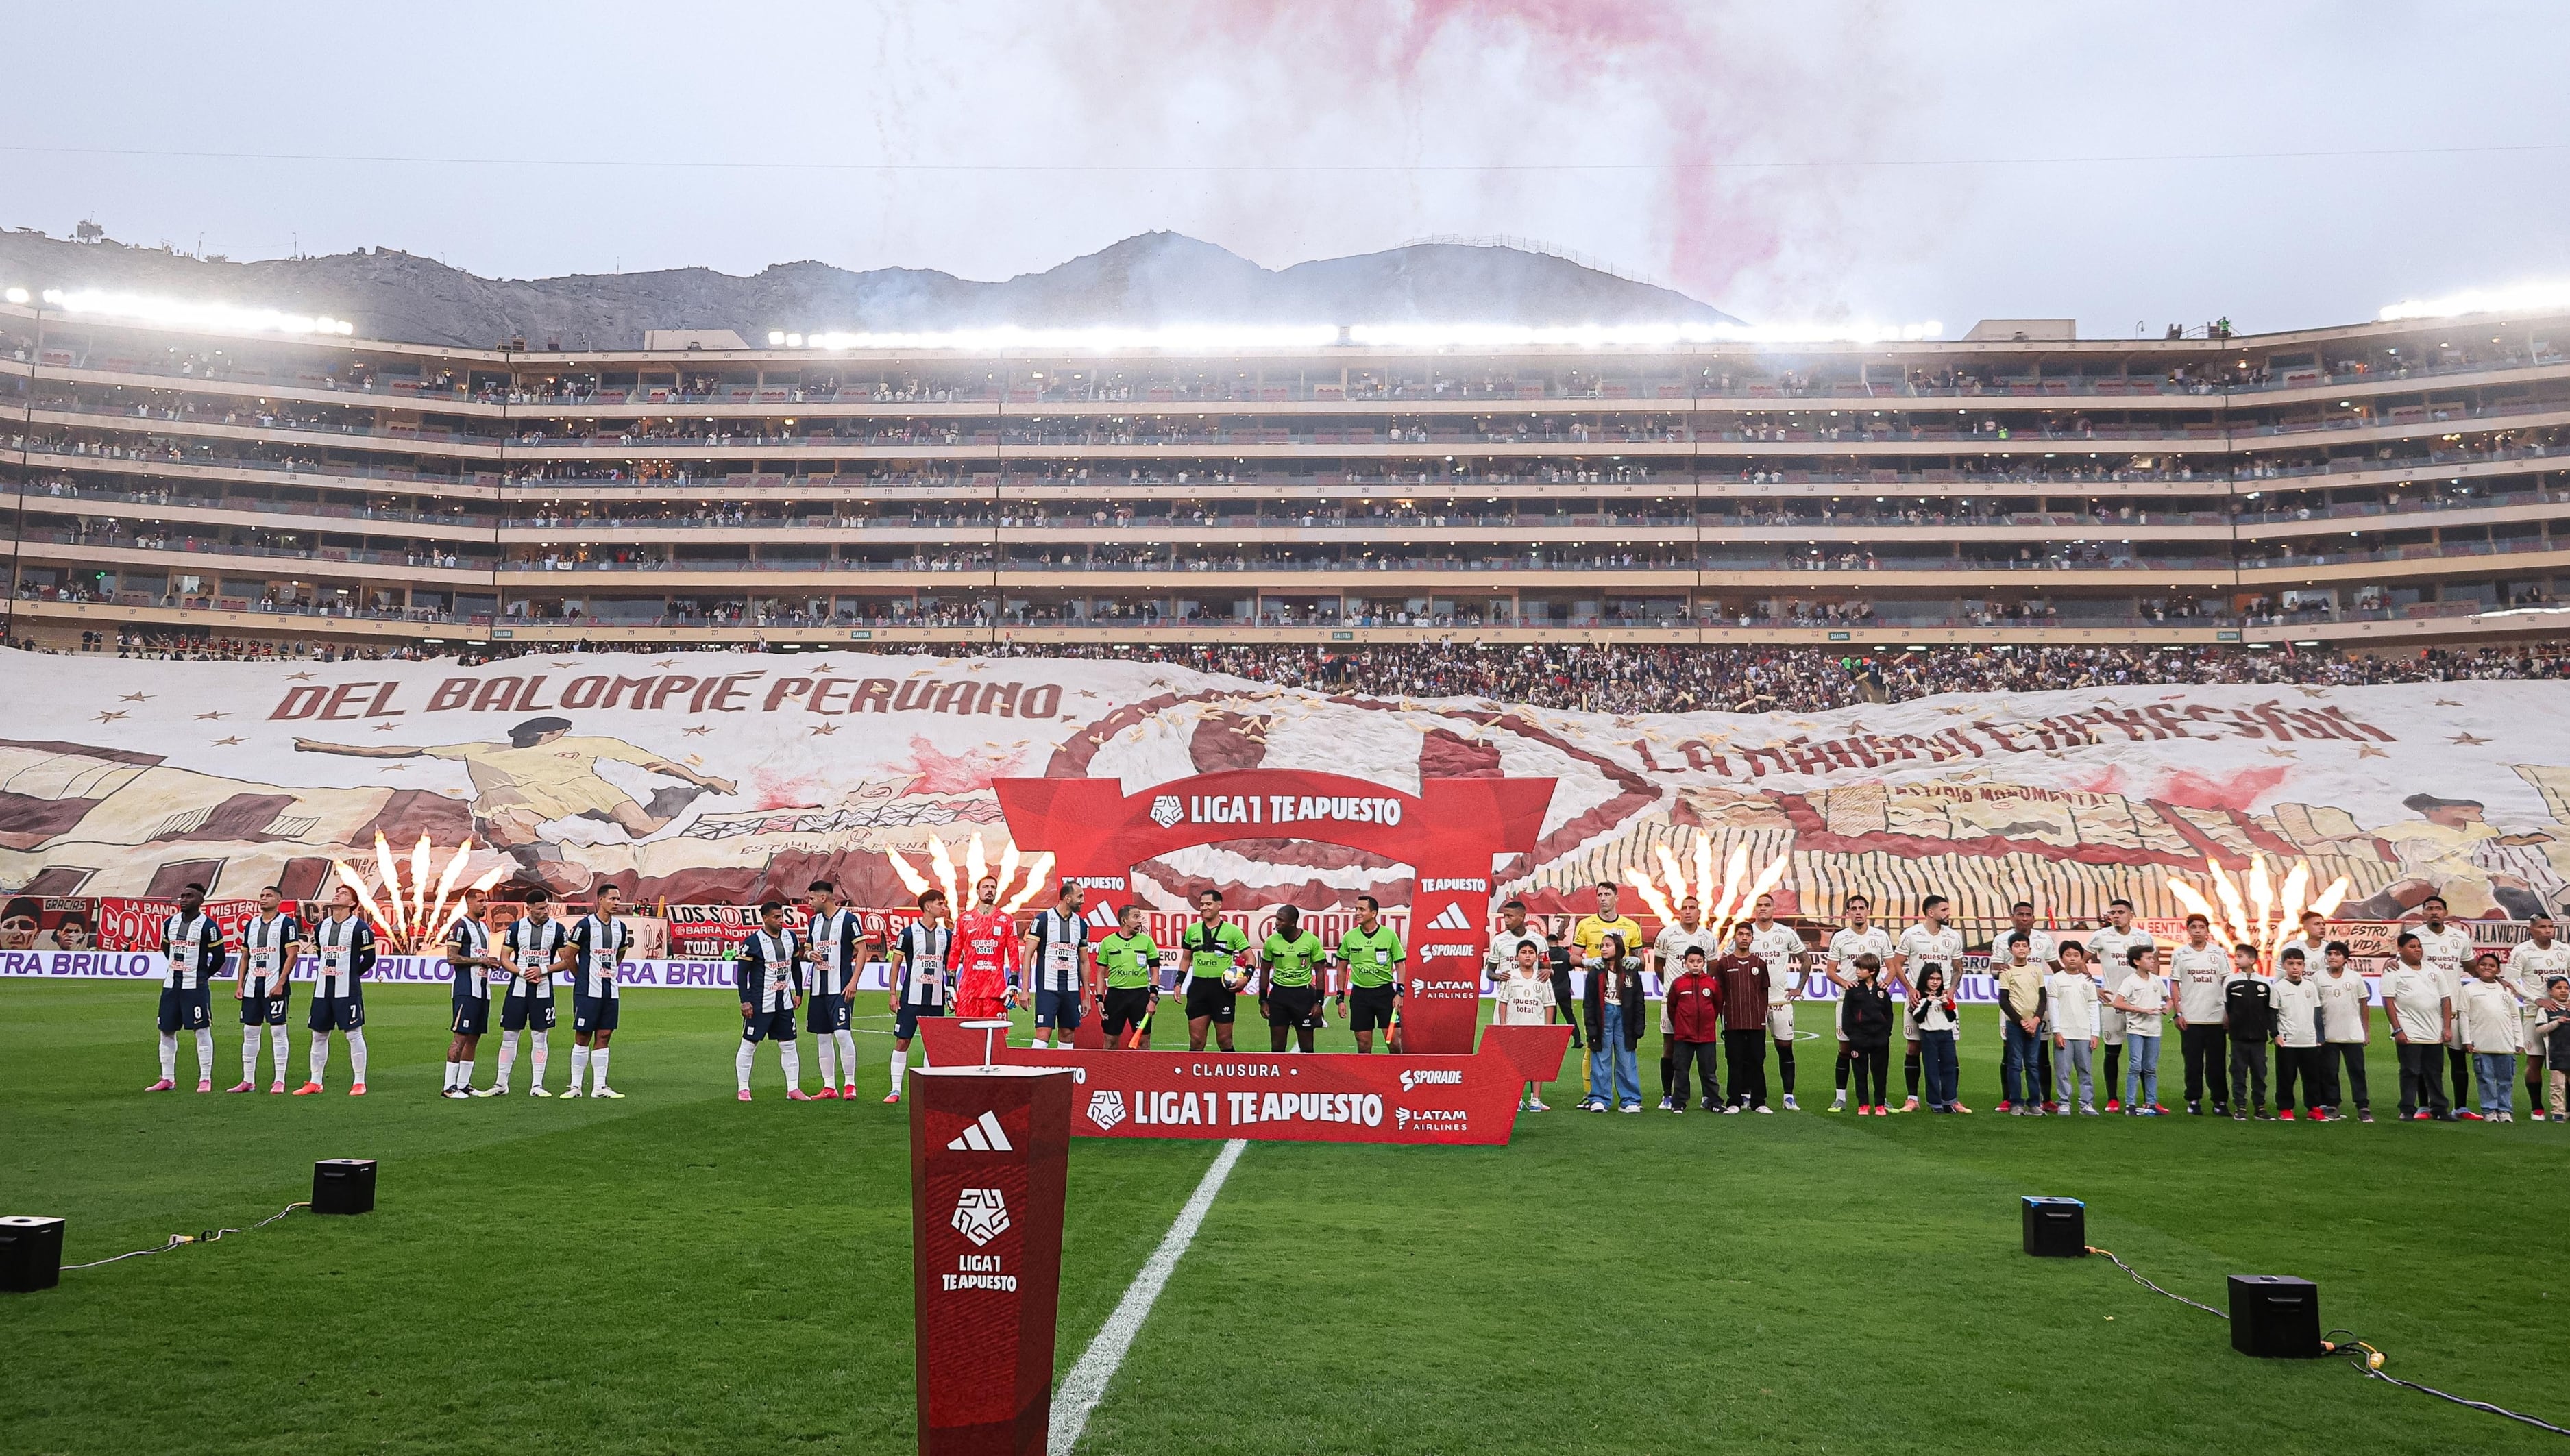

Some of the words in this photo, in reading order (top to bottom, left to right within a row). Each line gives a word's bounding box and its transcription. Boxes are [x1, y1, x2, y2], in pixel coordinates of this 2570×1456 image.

[267, 681, 406, 721] DEL
[423, 669, 768, 714] BALOMPIÉ
[45, 898, 86, 911] GRACIAS
[124, 900, 140, 912] LA
[143, 903, 181, 916] BAND
[671, 906, 707, 924] LOS
[685, 926, 722, 935] BARRA
[683, 941, 719, 954] TODA
[971, 939, 999, 948] apuesta
[1050, 941, 1078, 951] apuesta
[2352, 939, 2382, 950] VIDA
[250, 946, 276, 954] apuesta
[521, 949, 549, 958] apuesta
[976, 947, 994, 955] total
[1432, 943, 1475, 957] SPORADE
[324, 952, 341, 960] total
[916, 954, 943, 962] apuesta
[1918, 953, 1948, 961] apuesta
[2427, 954, 2459, 963] apuesta
[51, 954, 151, 976] BRILLO
[921, 961, 938, 969] total
[1197, 959, 1218, 967] Kuria
[774, 967, 790, 976] total
[1117, 969, 1139, 977] Kuria
[1358, 967, 1380, 975] Kuria
[2187, 968, 2217, 976] apuesta
[2533, 967, 2566, 976] apuesta
[1427, 980, 1474, 990] LATAM
[1513, 998, 1539, 1006] apuesta
[270, 1000, 284, 1015] 27
[350, 1004, 357, 1018] 7
[1516, 1006, 1534, 1014] total
[194, 1006, 201, 1019] 8
[545, 1007, 556, 1021] 22
[838, 1008, 846, 1020] 5
[1192, 1063, 1280, 1077] CLAUSURA
[1412, 1070, 1463, 1084] SPORADE
[1412, 1110, 1467, 1120] LATAM
[1412, 1123, 1467, 1131] AIRLINES
